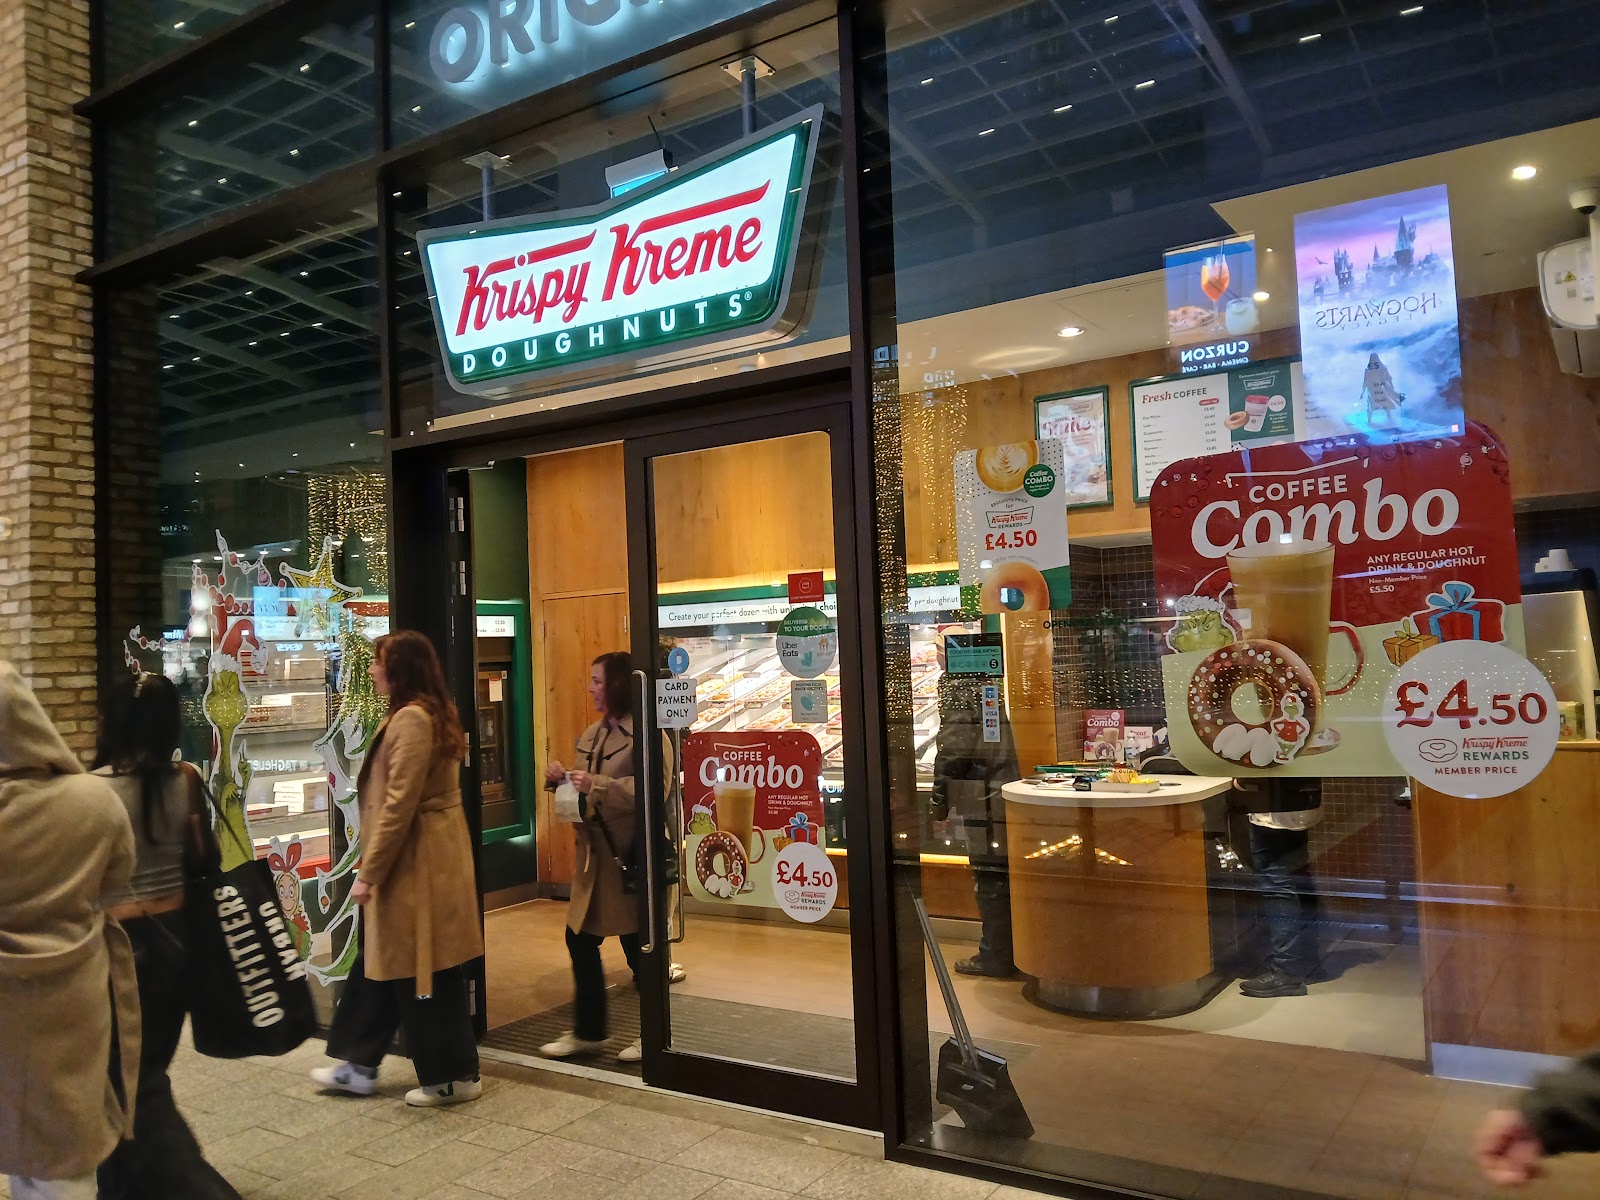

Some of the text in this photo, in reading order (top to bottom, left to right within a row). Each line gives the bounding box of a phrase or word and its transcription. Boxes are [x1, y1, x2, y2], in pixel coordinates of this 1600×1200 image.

[456, 179, 771, 337] Krispy Kreme
[1142, 388, 1207, 404] Fresh COFFEE
[1025, 475, 1054, 485] COMBO
[1249, 474, 1347, 503] COFFEE
[1191, 477, 1459, 558] Combo
[985, 529, 1037, 551] £4.50
[1367, 546, 1474, 564] ANY REGULAR HOT
[1368, 556, 1486, 575] DRINK & DOUGHNUT
[1369, 575, 1410, 584] Non-Member
[1369, 585, 1395, 593] £5.50
[926, 596, 959, 607] doughnut
[668, 611, 692, 622] Create
[693, 612, 709, 623] your
[711, 608, 737, 623] perfect
[738, 607, 759, 617] dozen
[665, 682, 689, 691] CARD
[658, 695, 697, 705] PAYMENT
[1395, 679, 1548, 730] £4.50
[666, 708, 689, 718] ONLY
[1087, 718, 1119, 727] Combo
[1462, 736, 1528, 750] Krispy Kreme
[723, 751, 762, 761] COFFEE
[1463, 750, 1529, 761] REWARDS
[699, 755, 804, 789] Combo
[1435, 766, 1517, 775] MEMBER PRICE
[777, 860, 833, 887] £4.50
[258, 901, 308, 981] URBAN
[213, 885, 285, 1028] OUTFITTERS
